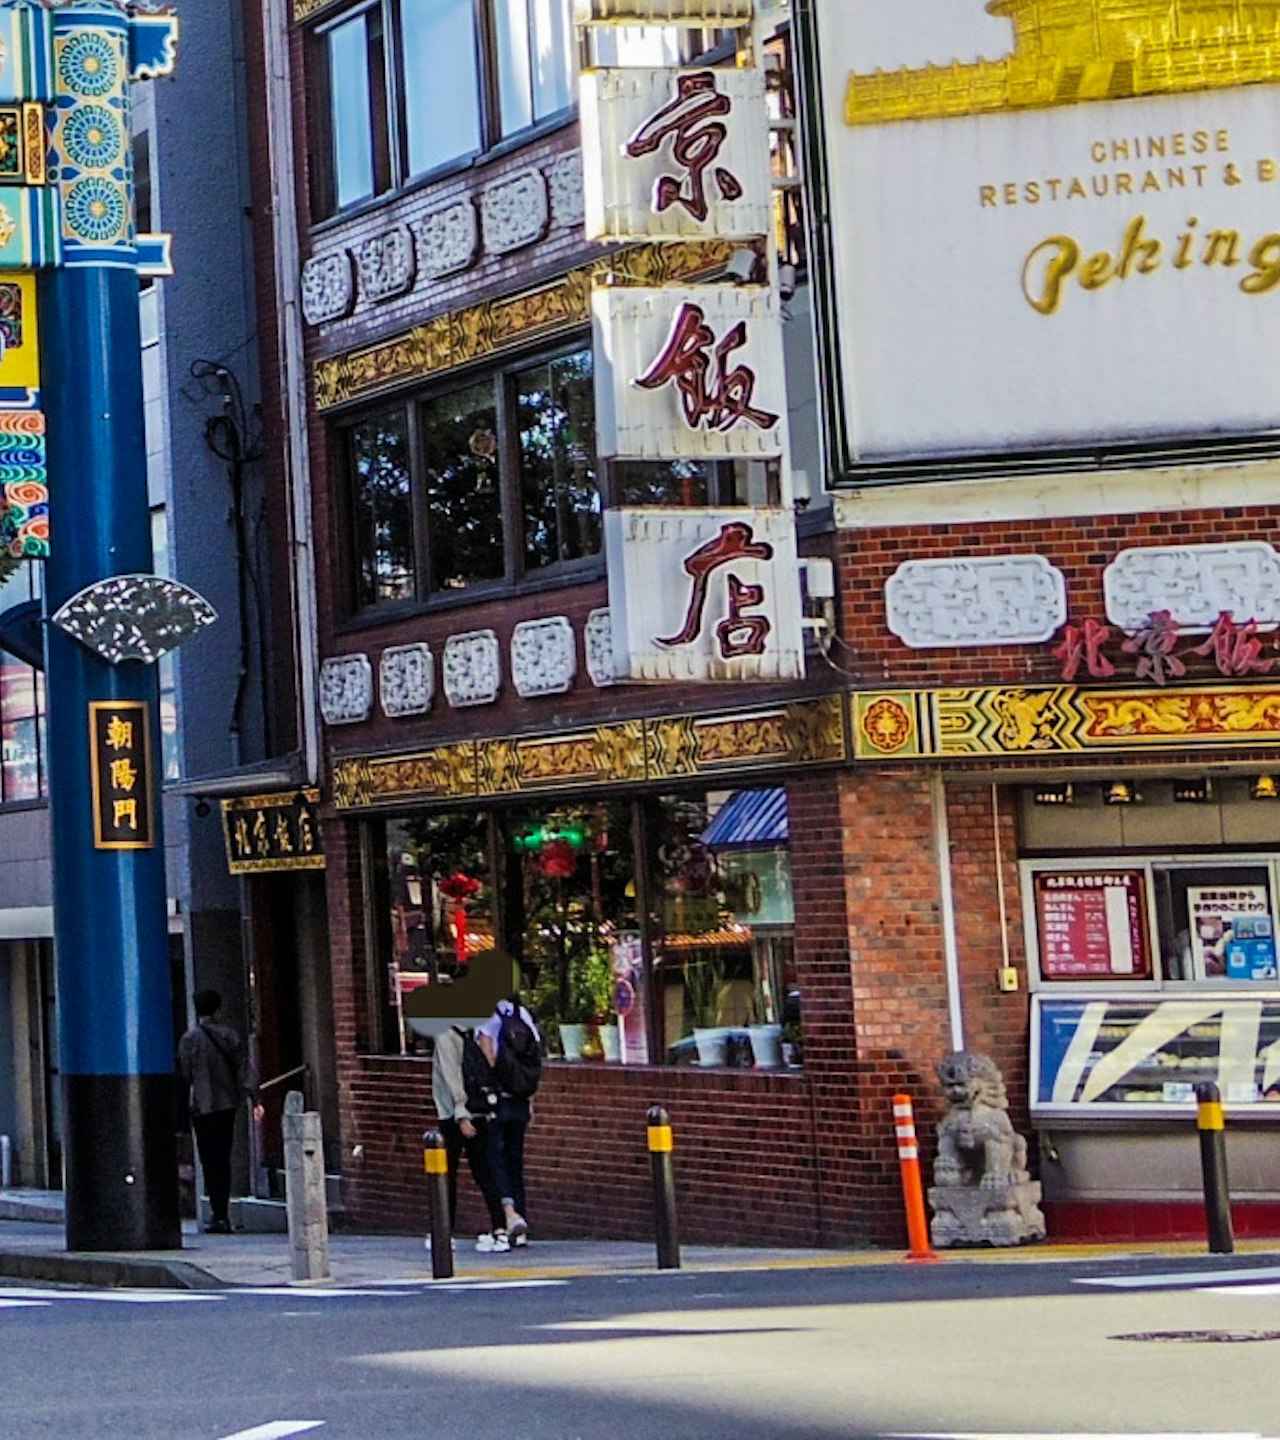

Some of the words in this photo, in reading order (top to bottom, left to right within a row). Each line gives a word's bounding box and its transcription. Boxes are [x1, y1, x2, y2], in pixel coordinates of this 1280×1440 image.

[1091, 129, 1229, 163] CHINESE
[979, 165, 1208, 208] RESTAURANT
[1221, 161, 1241, 187] &
[1021, 214, 1280, 315] Peking
[106, 715, 138, 831] 朝陽門
